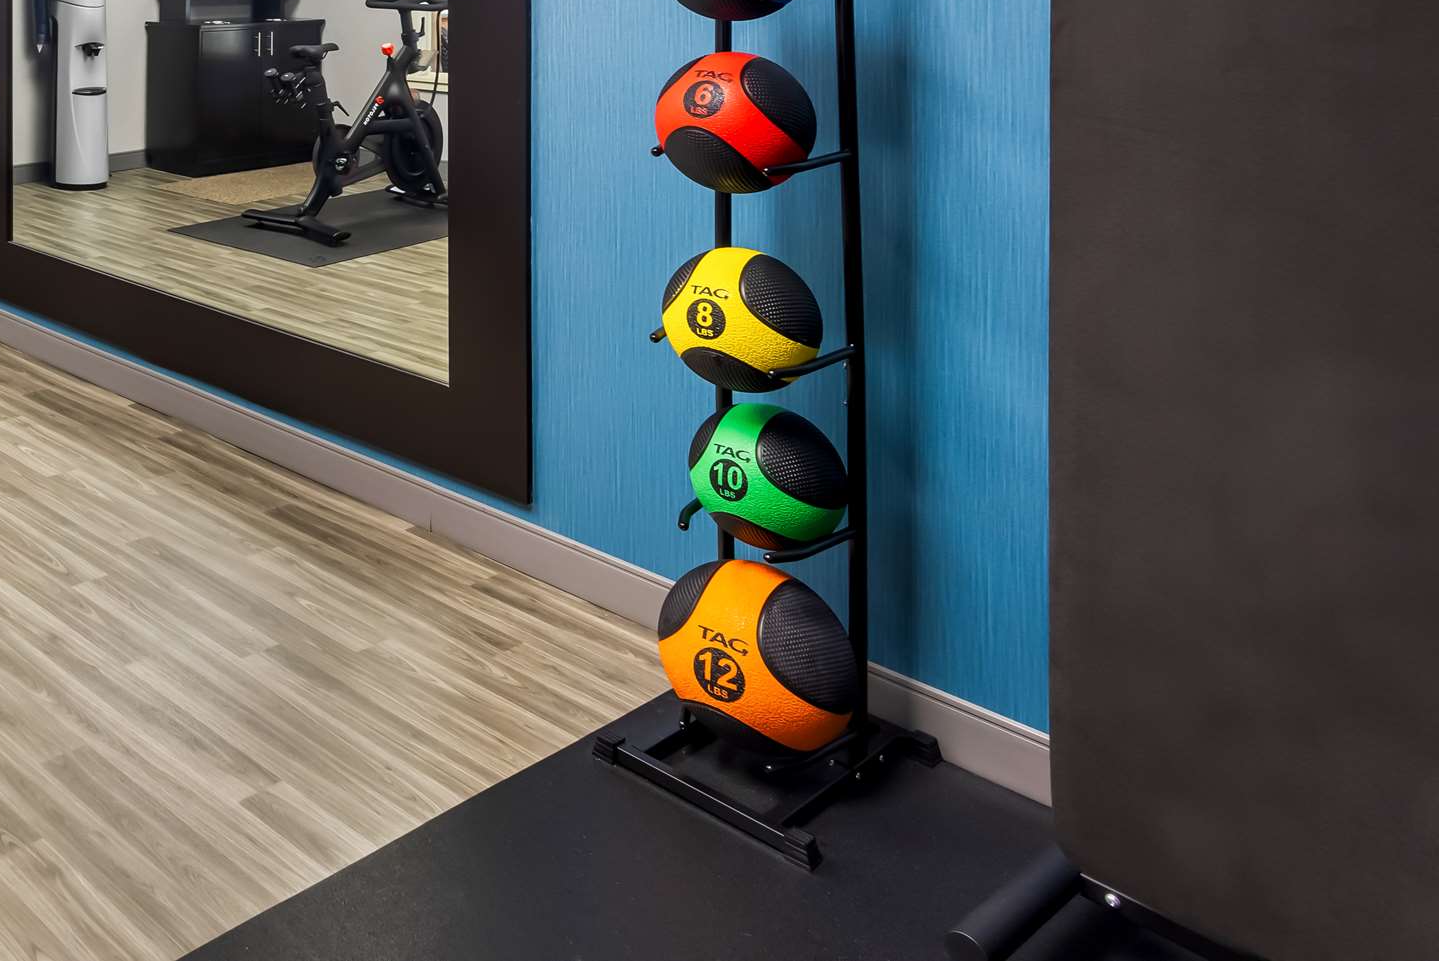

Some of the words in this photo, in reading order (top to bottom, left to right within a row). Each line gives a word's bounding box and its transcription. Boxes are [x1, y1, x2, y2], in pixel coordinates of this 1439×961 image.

[694, 70, 734, 83] TAG
[695, 84, 714, 106] 6
[691, 285, 729, 299] TAG
[696, 302, 713, 327] 8
[696, 328, 714, 337] LBS
[713, 443, 751, 463] TAG
[713, 462, 743, 490] 10
[719, 488, 736, 499] LBS
[698, 624, 750, 656] TAG
[698, 651, 738, 691] 12
[707, 684, 729, 699] LBS
